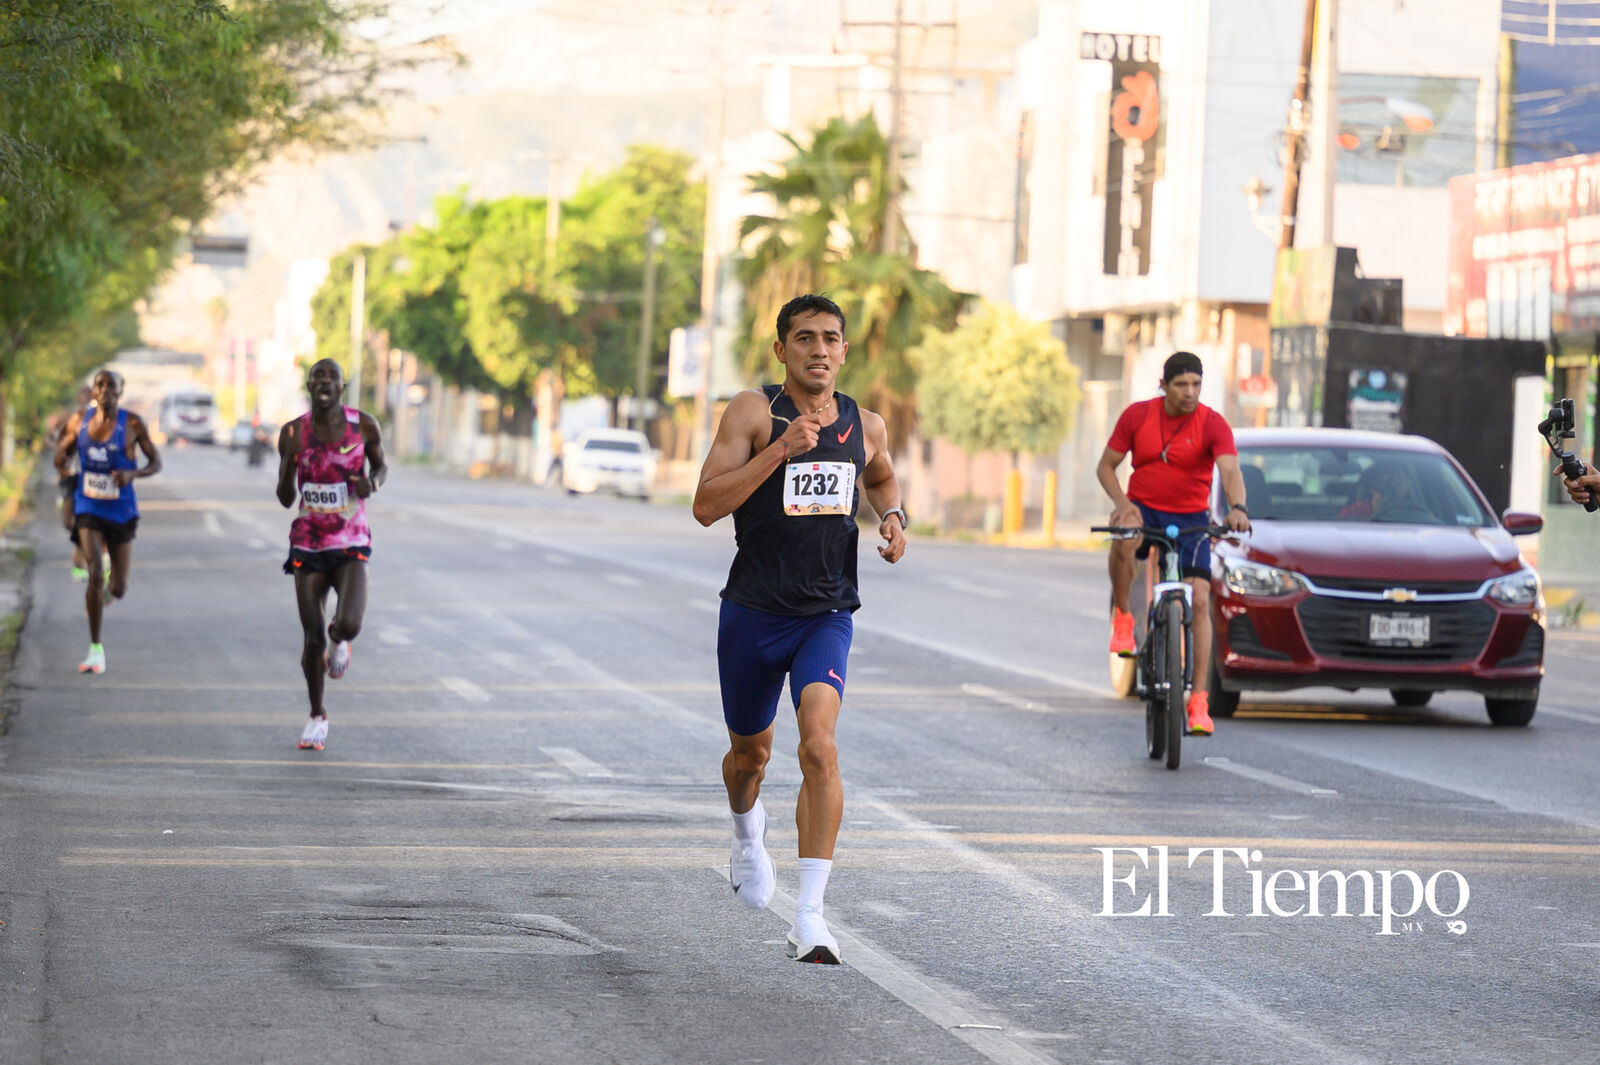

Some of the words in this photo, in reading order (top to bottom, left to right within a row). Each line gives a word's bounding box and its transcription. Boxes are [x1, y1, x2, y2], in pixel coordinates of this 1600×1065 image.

[1081, 34, 1160, 62] HOTEL
[792, 473, 839, 496] 1232
[304, 490, 338, 504] 0360
